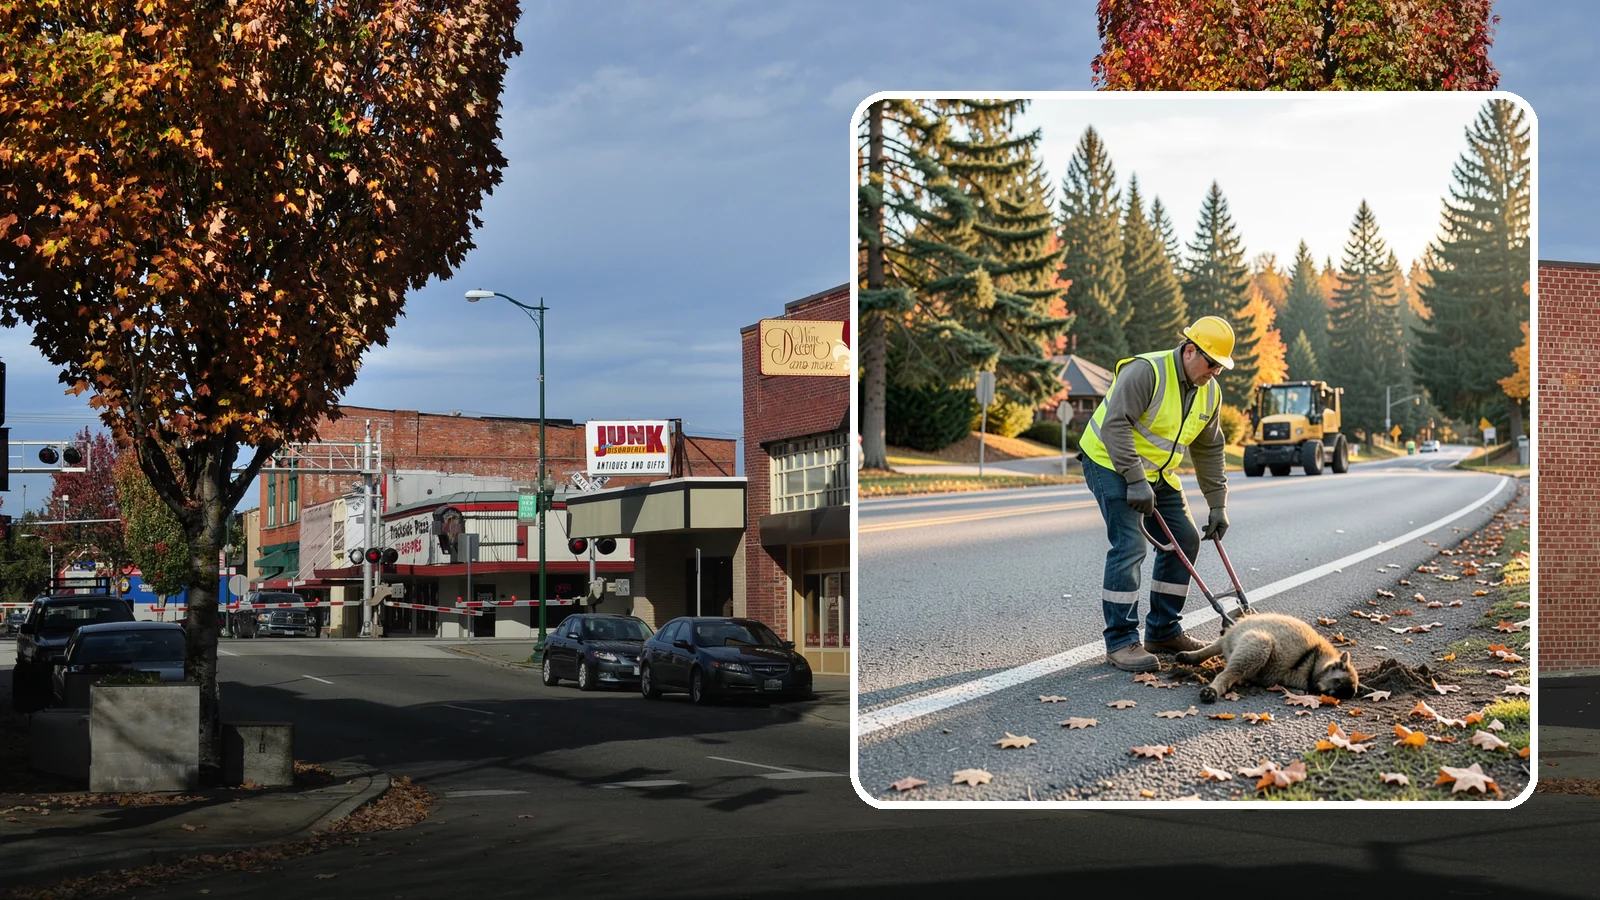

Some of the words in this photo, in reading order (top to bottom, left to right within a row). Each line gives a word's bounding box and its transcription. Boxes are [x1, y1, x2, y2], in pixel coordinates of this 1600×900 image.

[596, 425, 666, 457] JUNK
[607, 446, 646, 454] DISORDERLY
[597, 461, 628, 470] ANTIQUES
[631, 461, 644, 470] AND
[647, 460, 666, 469] GIFTS
[573, 473, 588, 490] RAIL
[352, 498, 365, 511] CRO
